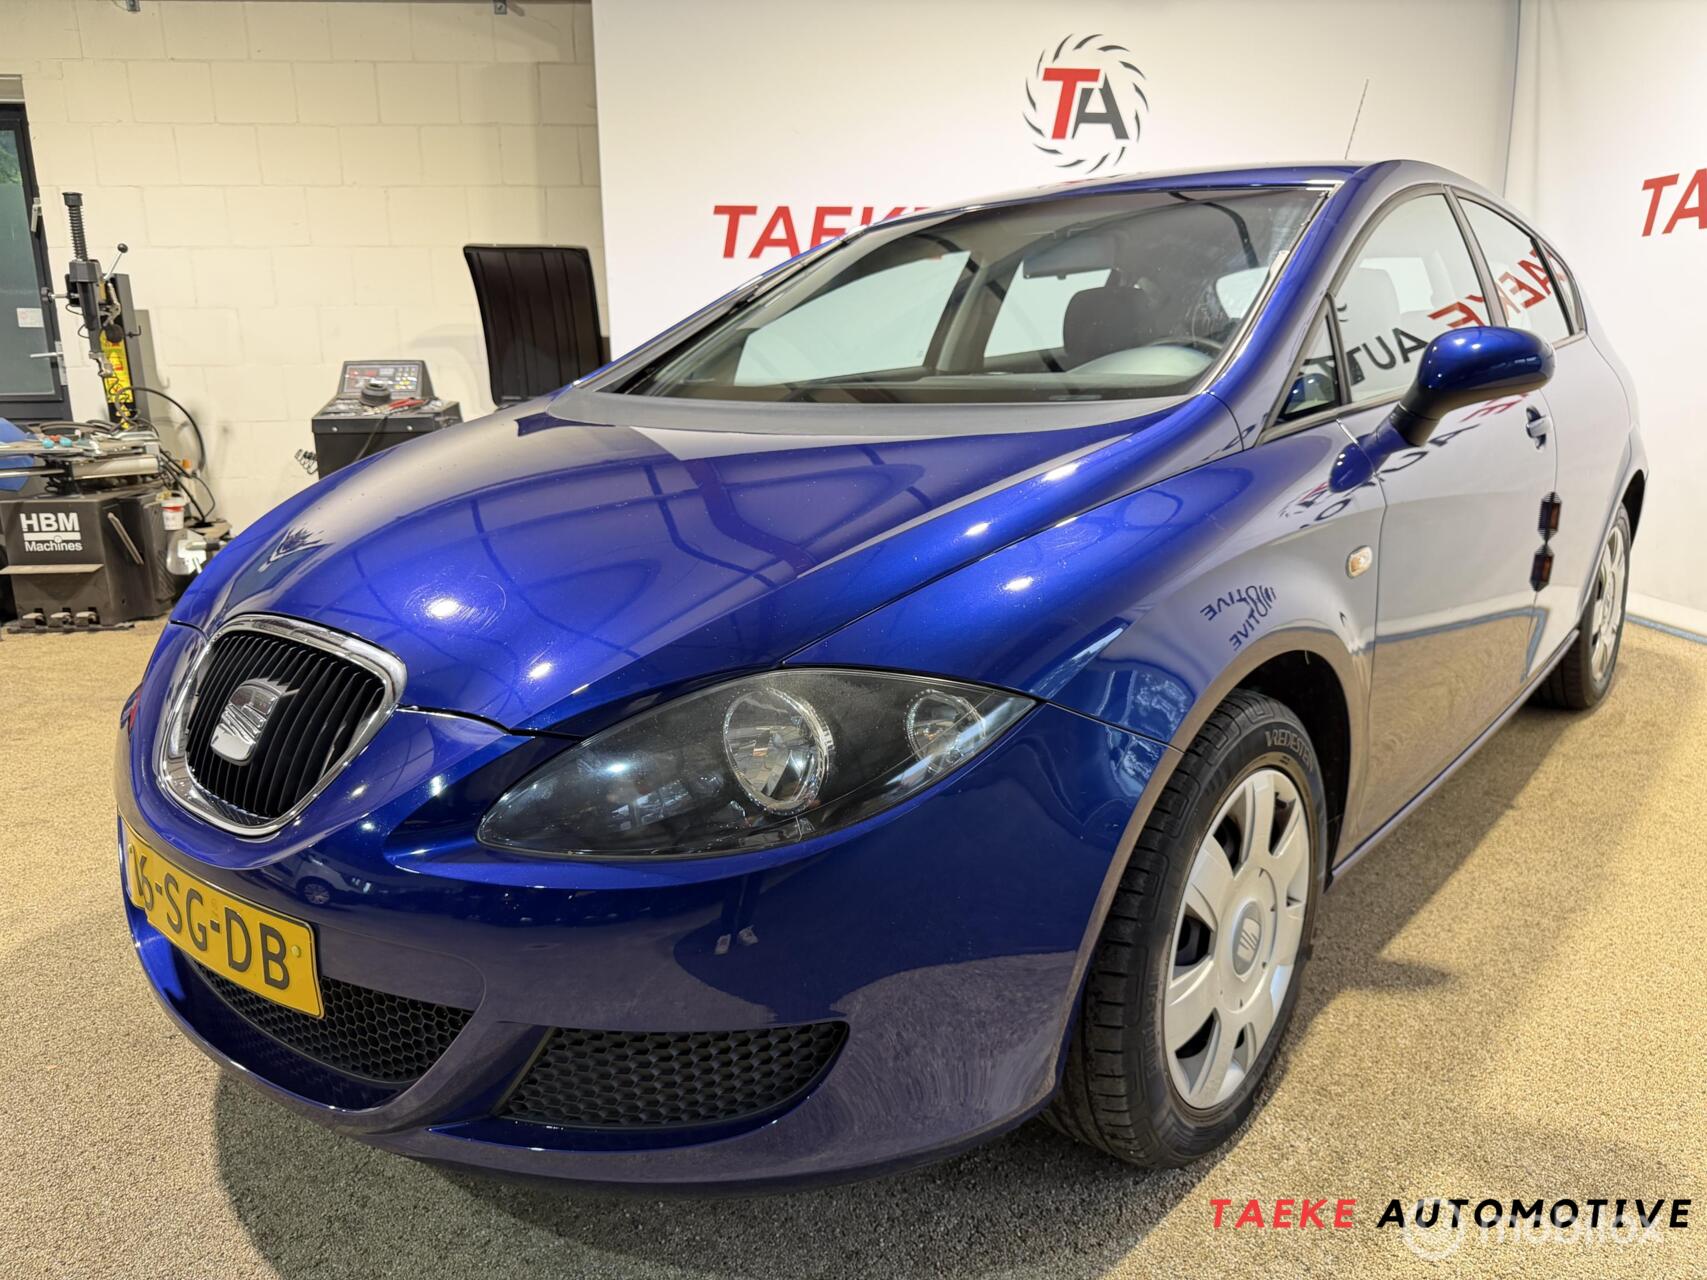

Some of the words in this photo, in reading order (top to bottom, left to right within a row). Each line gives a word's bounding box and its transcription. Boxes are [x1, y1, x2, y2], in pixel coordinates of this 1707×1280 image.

[1043, 68, 1129, 140] TA
[20, 512, 80, 532] HBM
[25, 541, 83, 552] Machines
